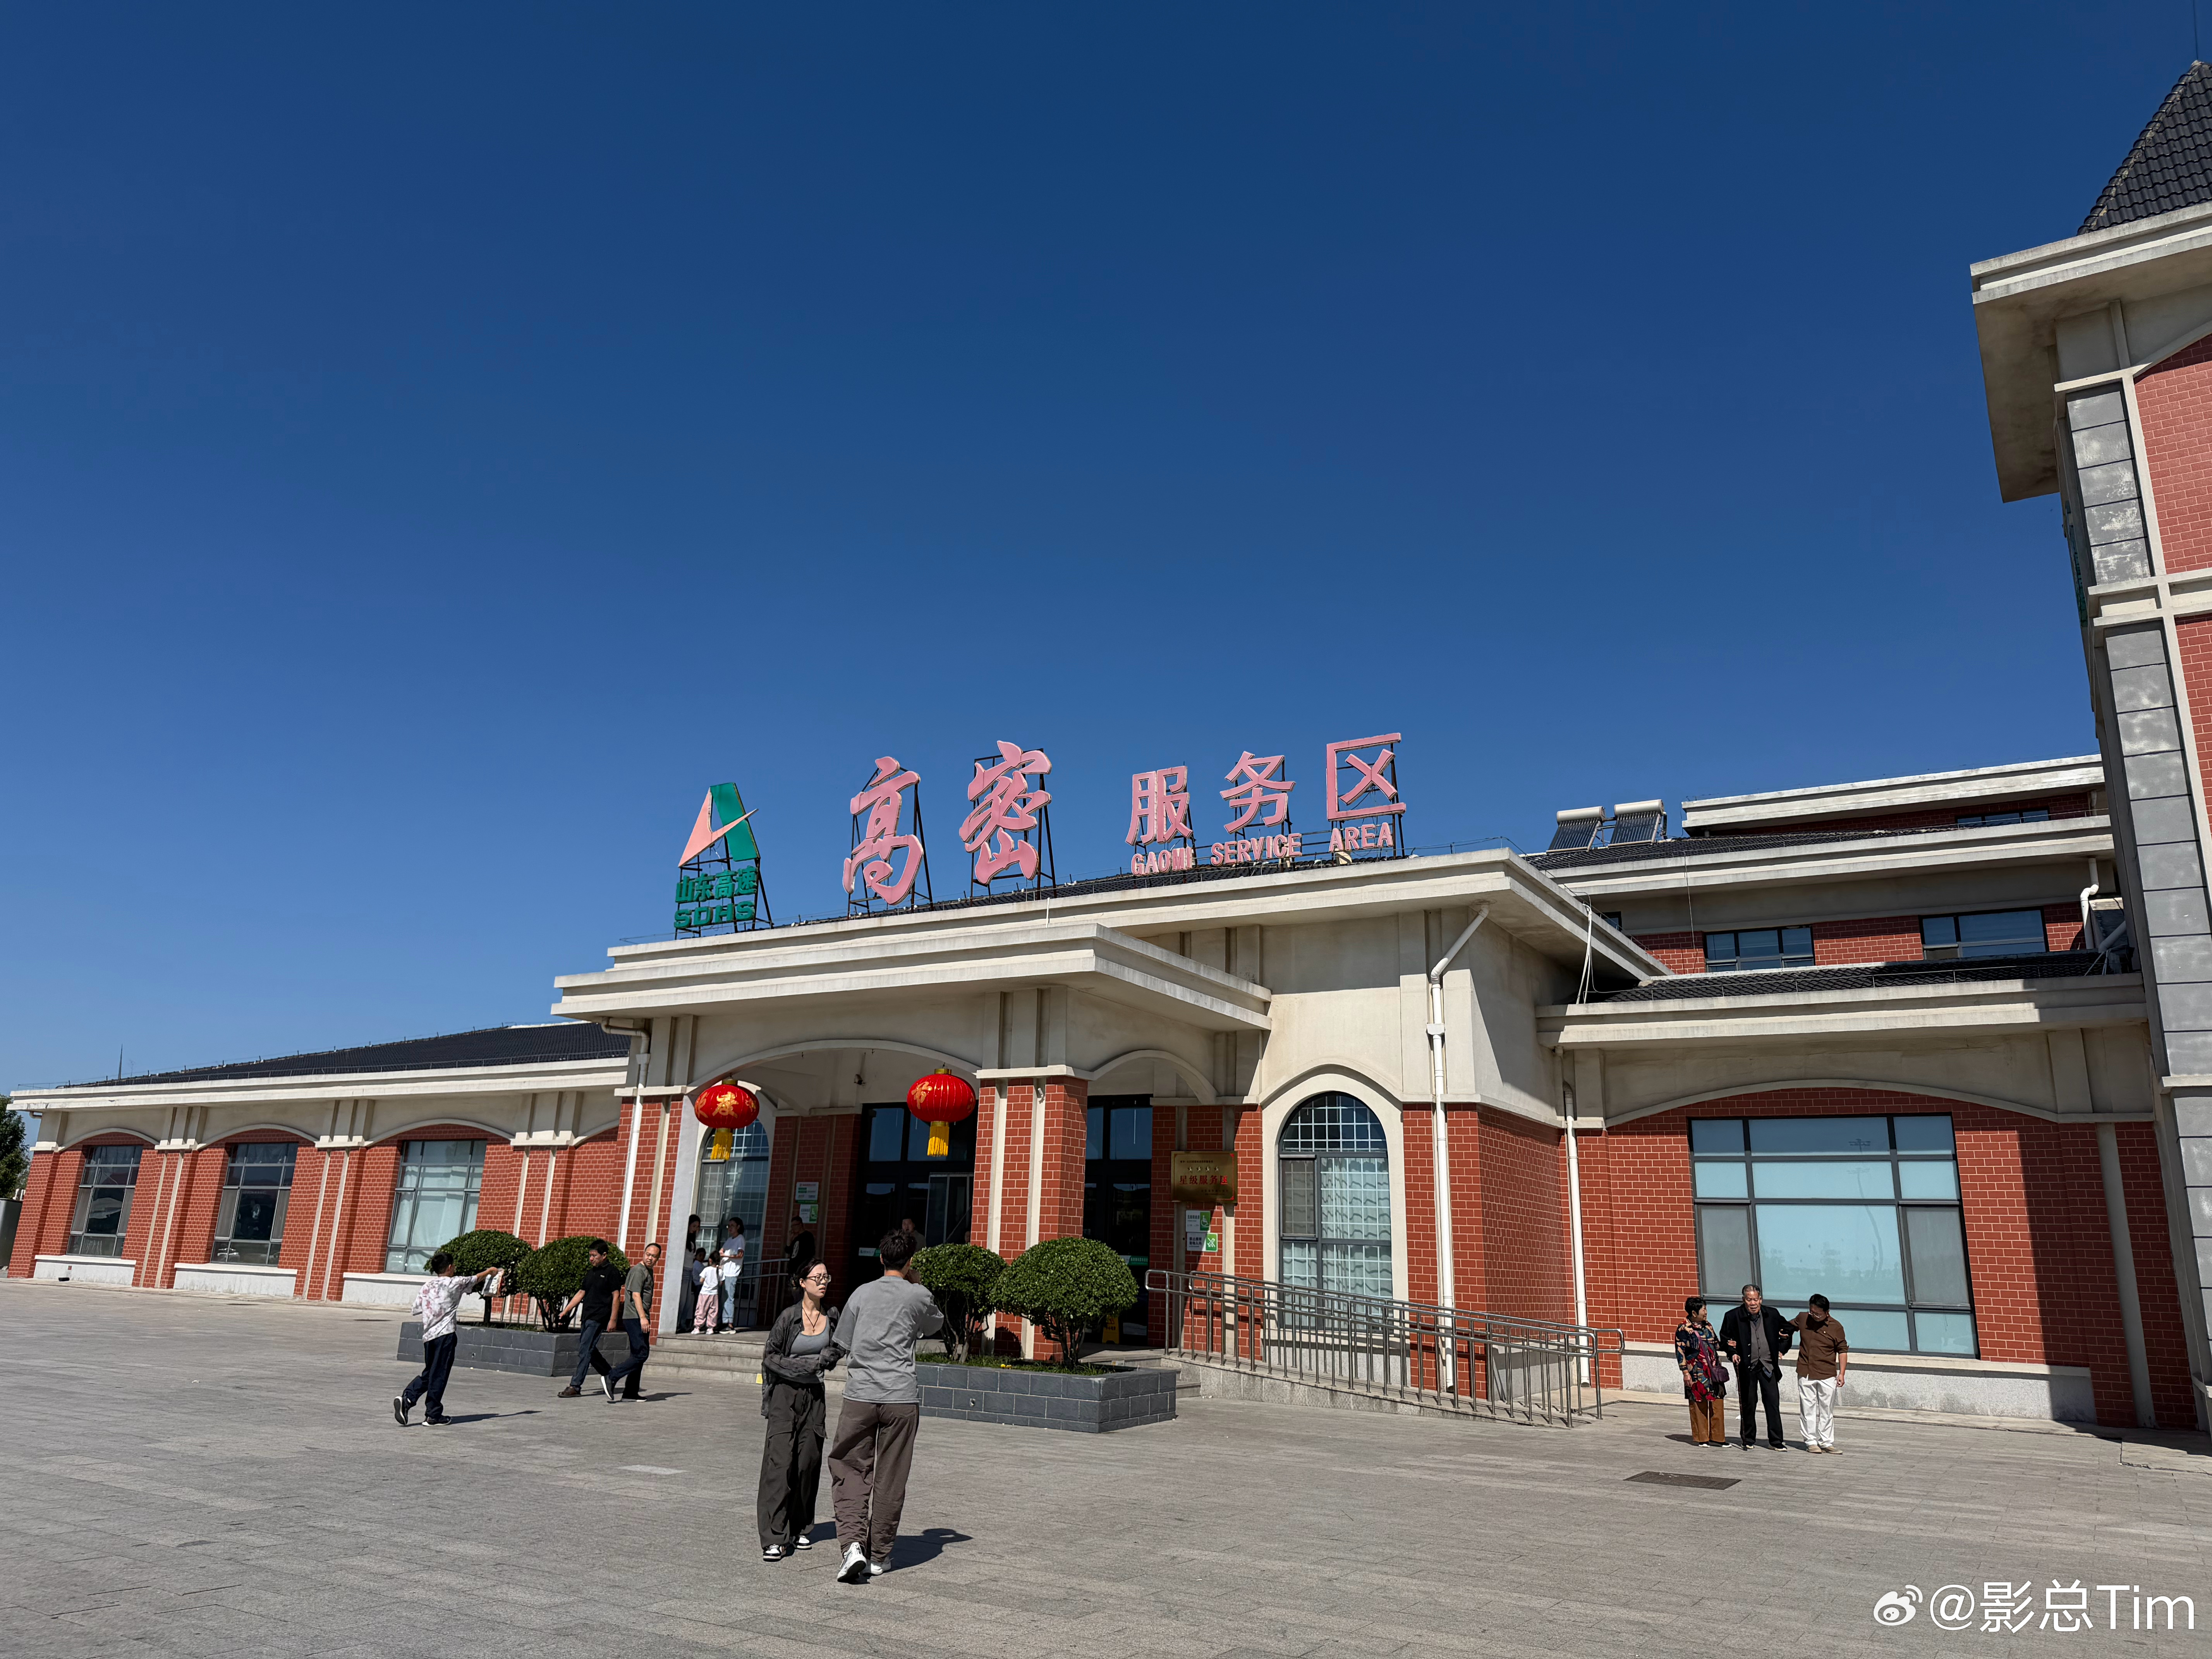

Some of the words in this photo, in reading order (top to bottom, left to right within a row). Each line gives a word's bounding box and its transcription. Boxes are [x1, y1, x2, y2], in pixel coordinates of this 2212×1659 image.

[843, 740, 1052, 905] 高密
[1125, 732, 1407, 846] 服务区
[1131, 846, 1193, 877] GAOMI
[1211, 832, 1302, 867] SERVICE
[1329, 822, 1394, 852] AREA
[675, 865, 758, 903] 山东高速
[674, 900, 756, 928] SDHS
